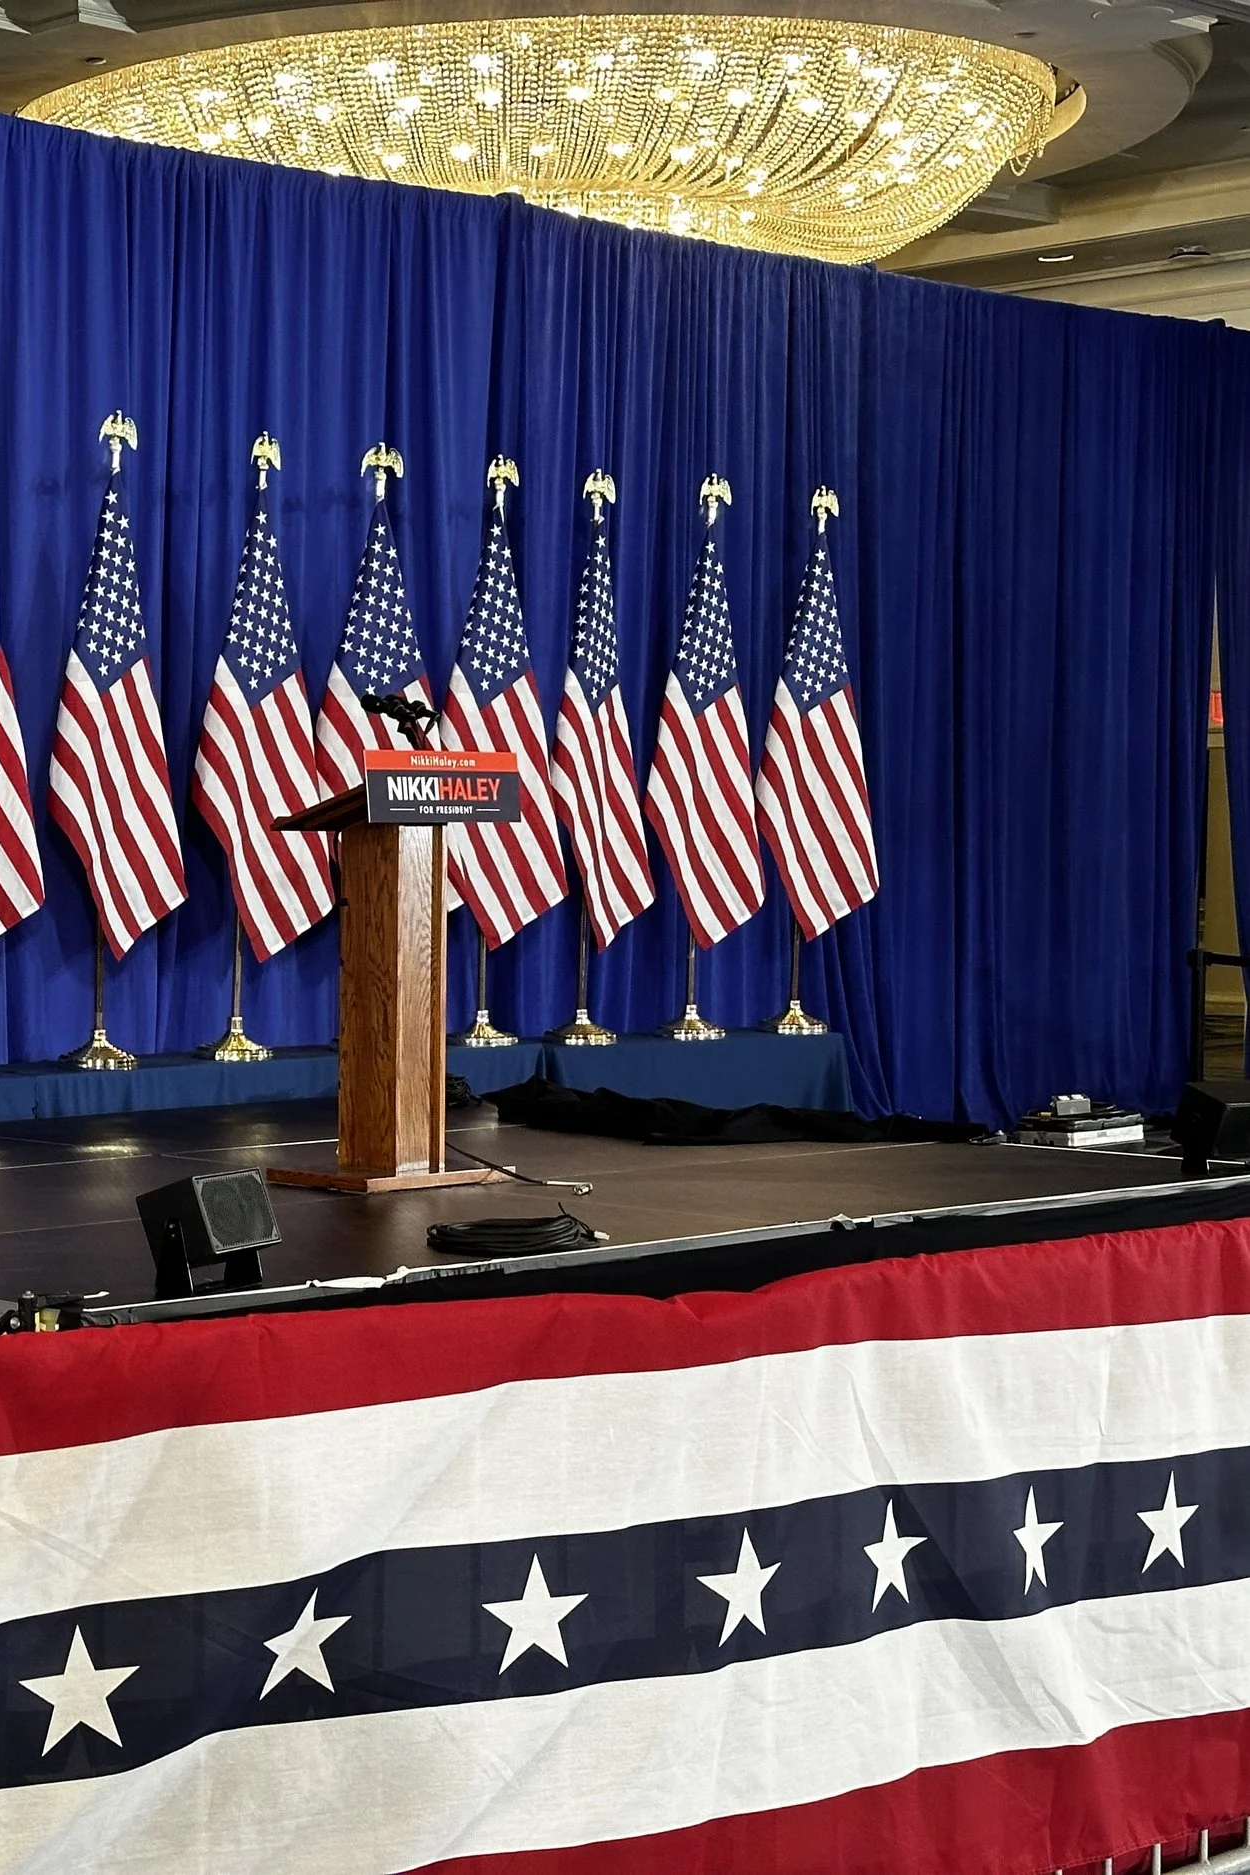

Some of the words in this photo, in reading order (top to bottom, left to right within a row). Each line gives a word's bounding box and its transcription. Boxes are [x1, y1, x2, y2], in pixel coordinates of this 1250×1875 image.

[410, 755, 476, 768] NikkiHaley.com
[419, 806, 434, 814] FOR
[436, 806, 473, 814] PRESIDENT
